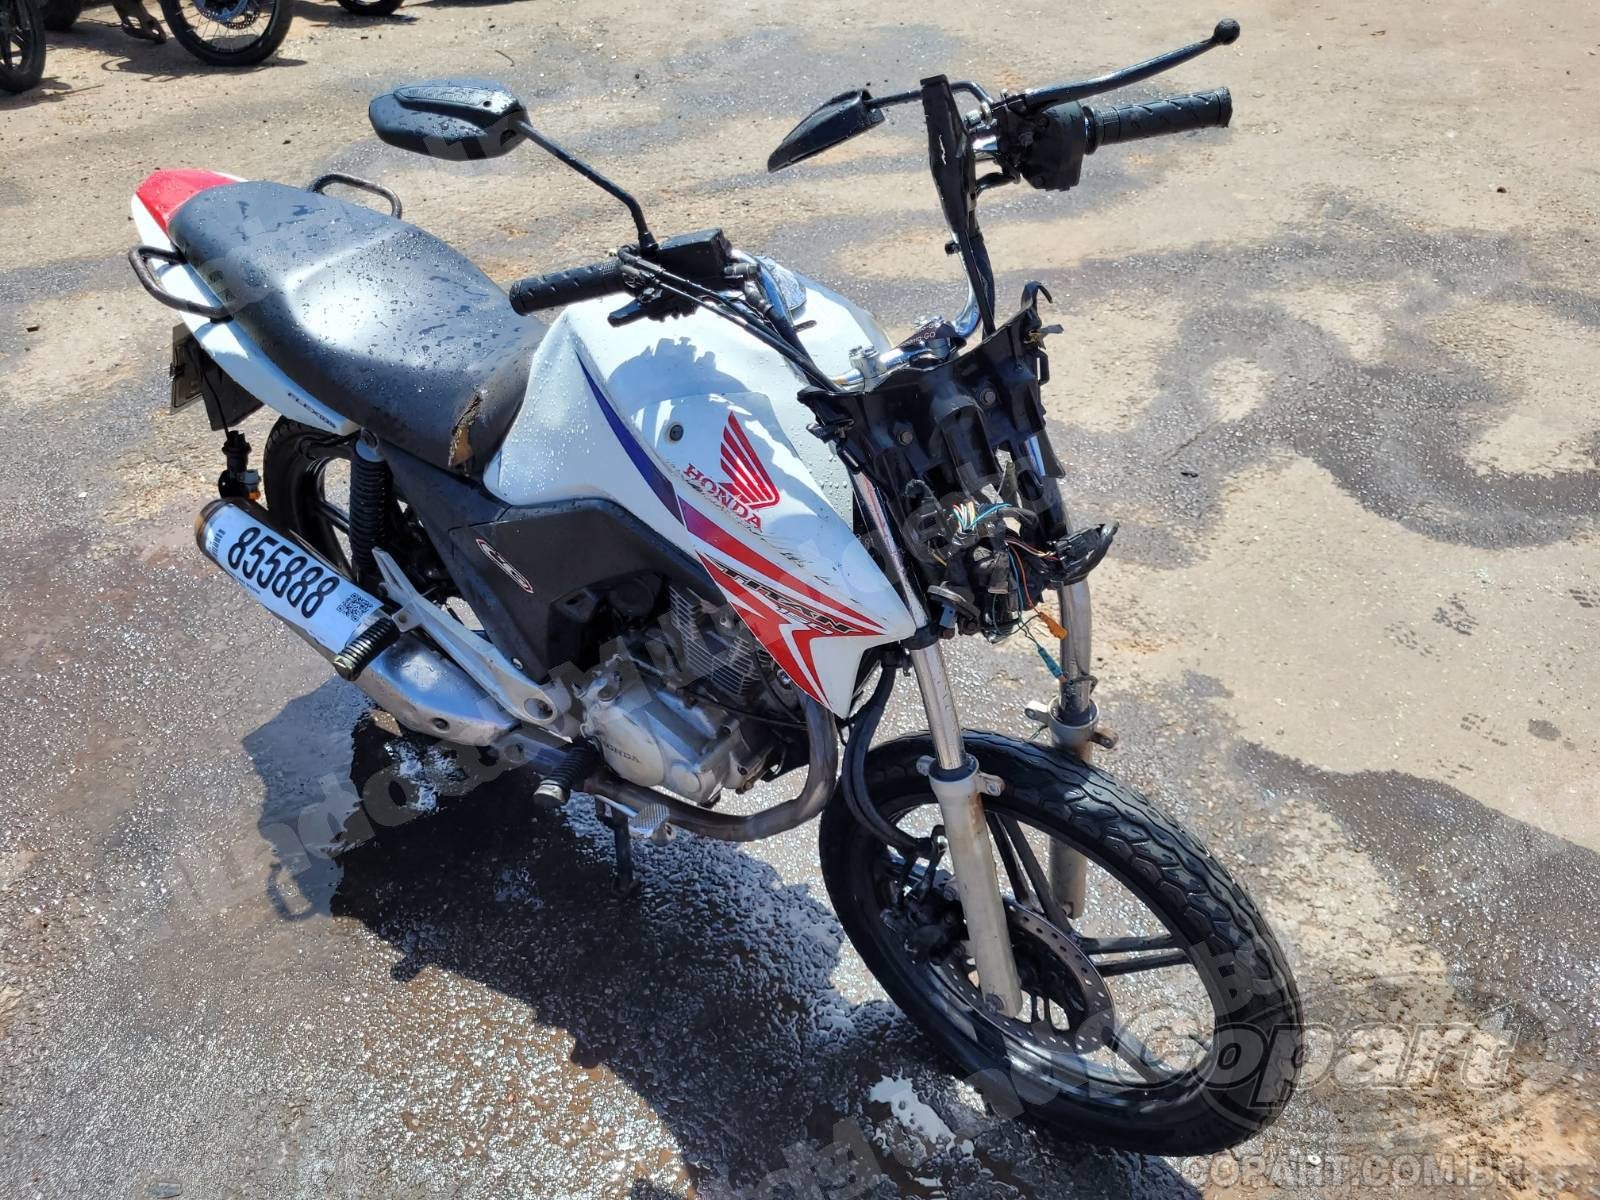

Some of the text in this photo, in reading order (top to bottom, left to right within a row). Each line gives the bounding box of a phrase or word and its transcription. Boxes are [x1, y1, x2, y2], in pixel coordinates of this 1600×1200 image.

[682, 463, 764, 533] HONDA
[226, 527, 340, 619] 855888
[704, 556, 862, 634] TITAN
